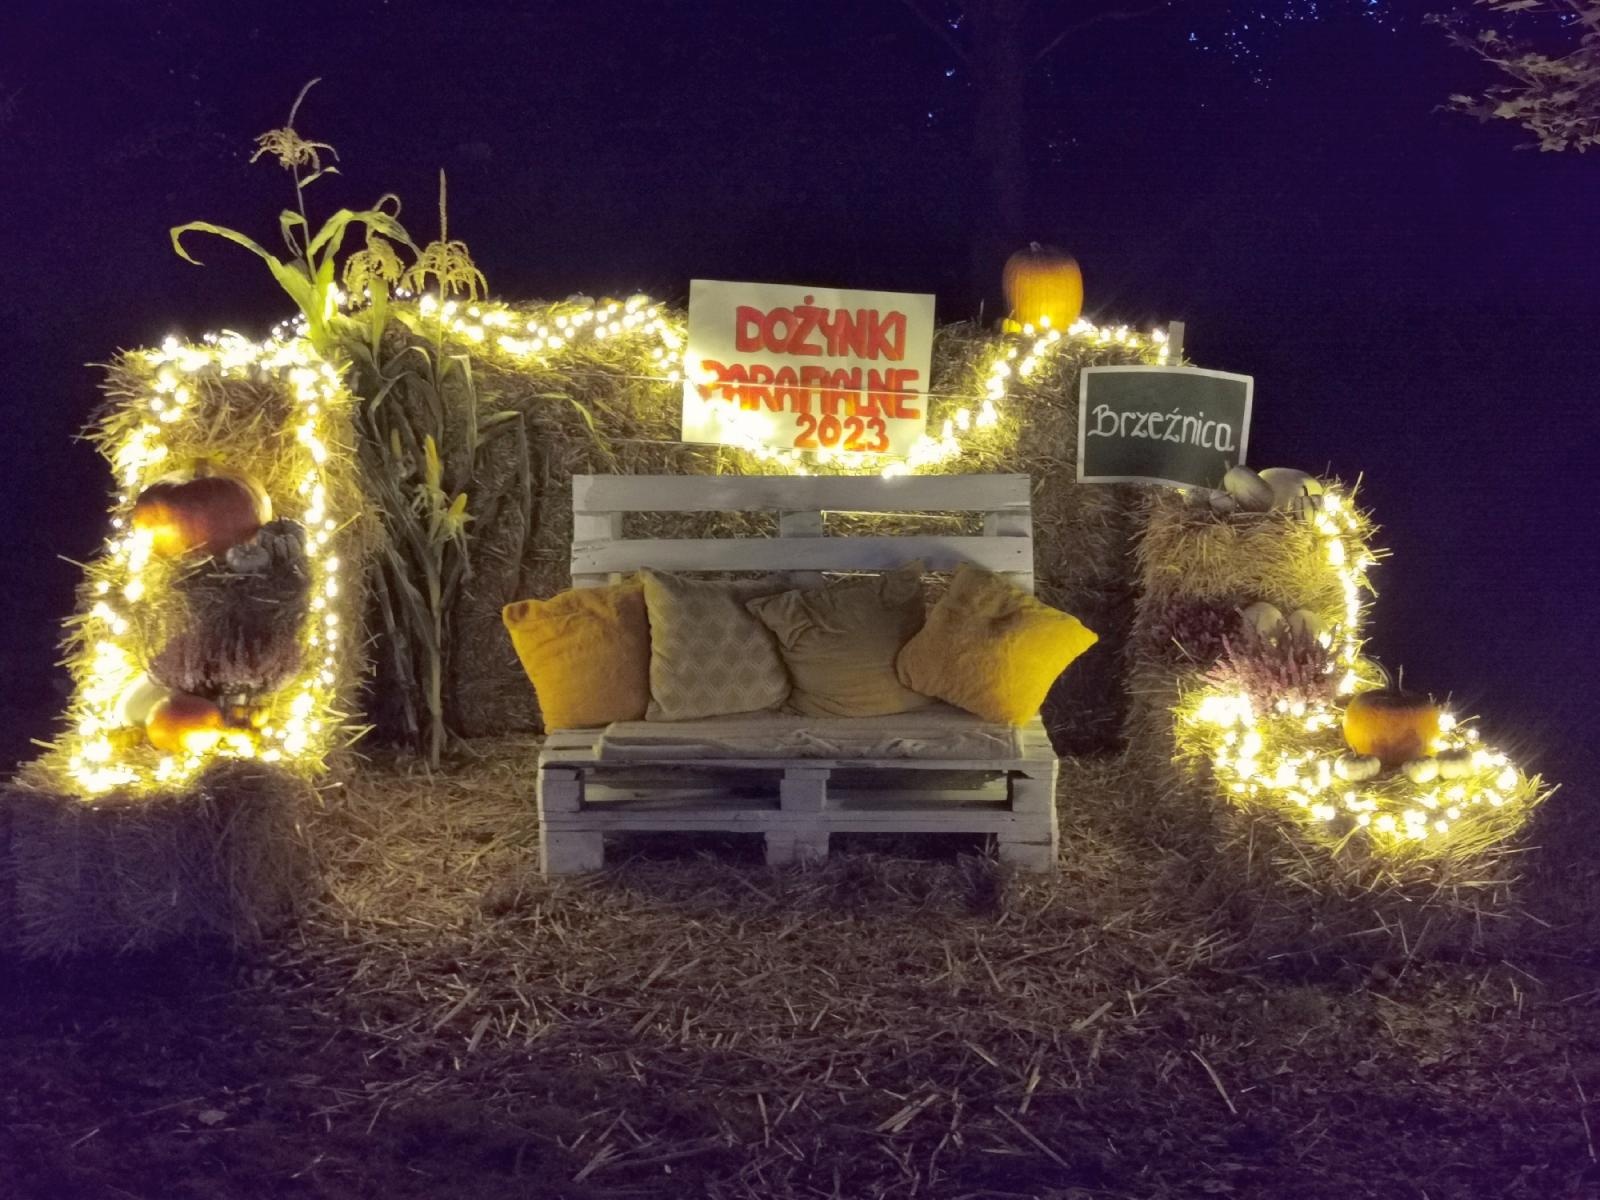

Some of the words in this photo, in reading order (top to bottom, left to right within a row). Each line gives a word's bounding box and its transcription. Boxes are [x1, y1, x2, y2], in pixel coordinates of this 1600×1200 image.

[735, 295, 906, 361] DOŻYNKI
[794, 413, 889, 453] 2023
[1087, 403, 1235, 452] Brzeźnica
